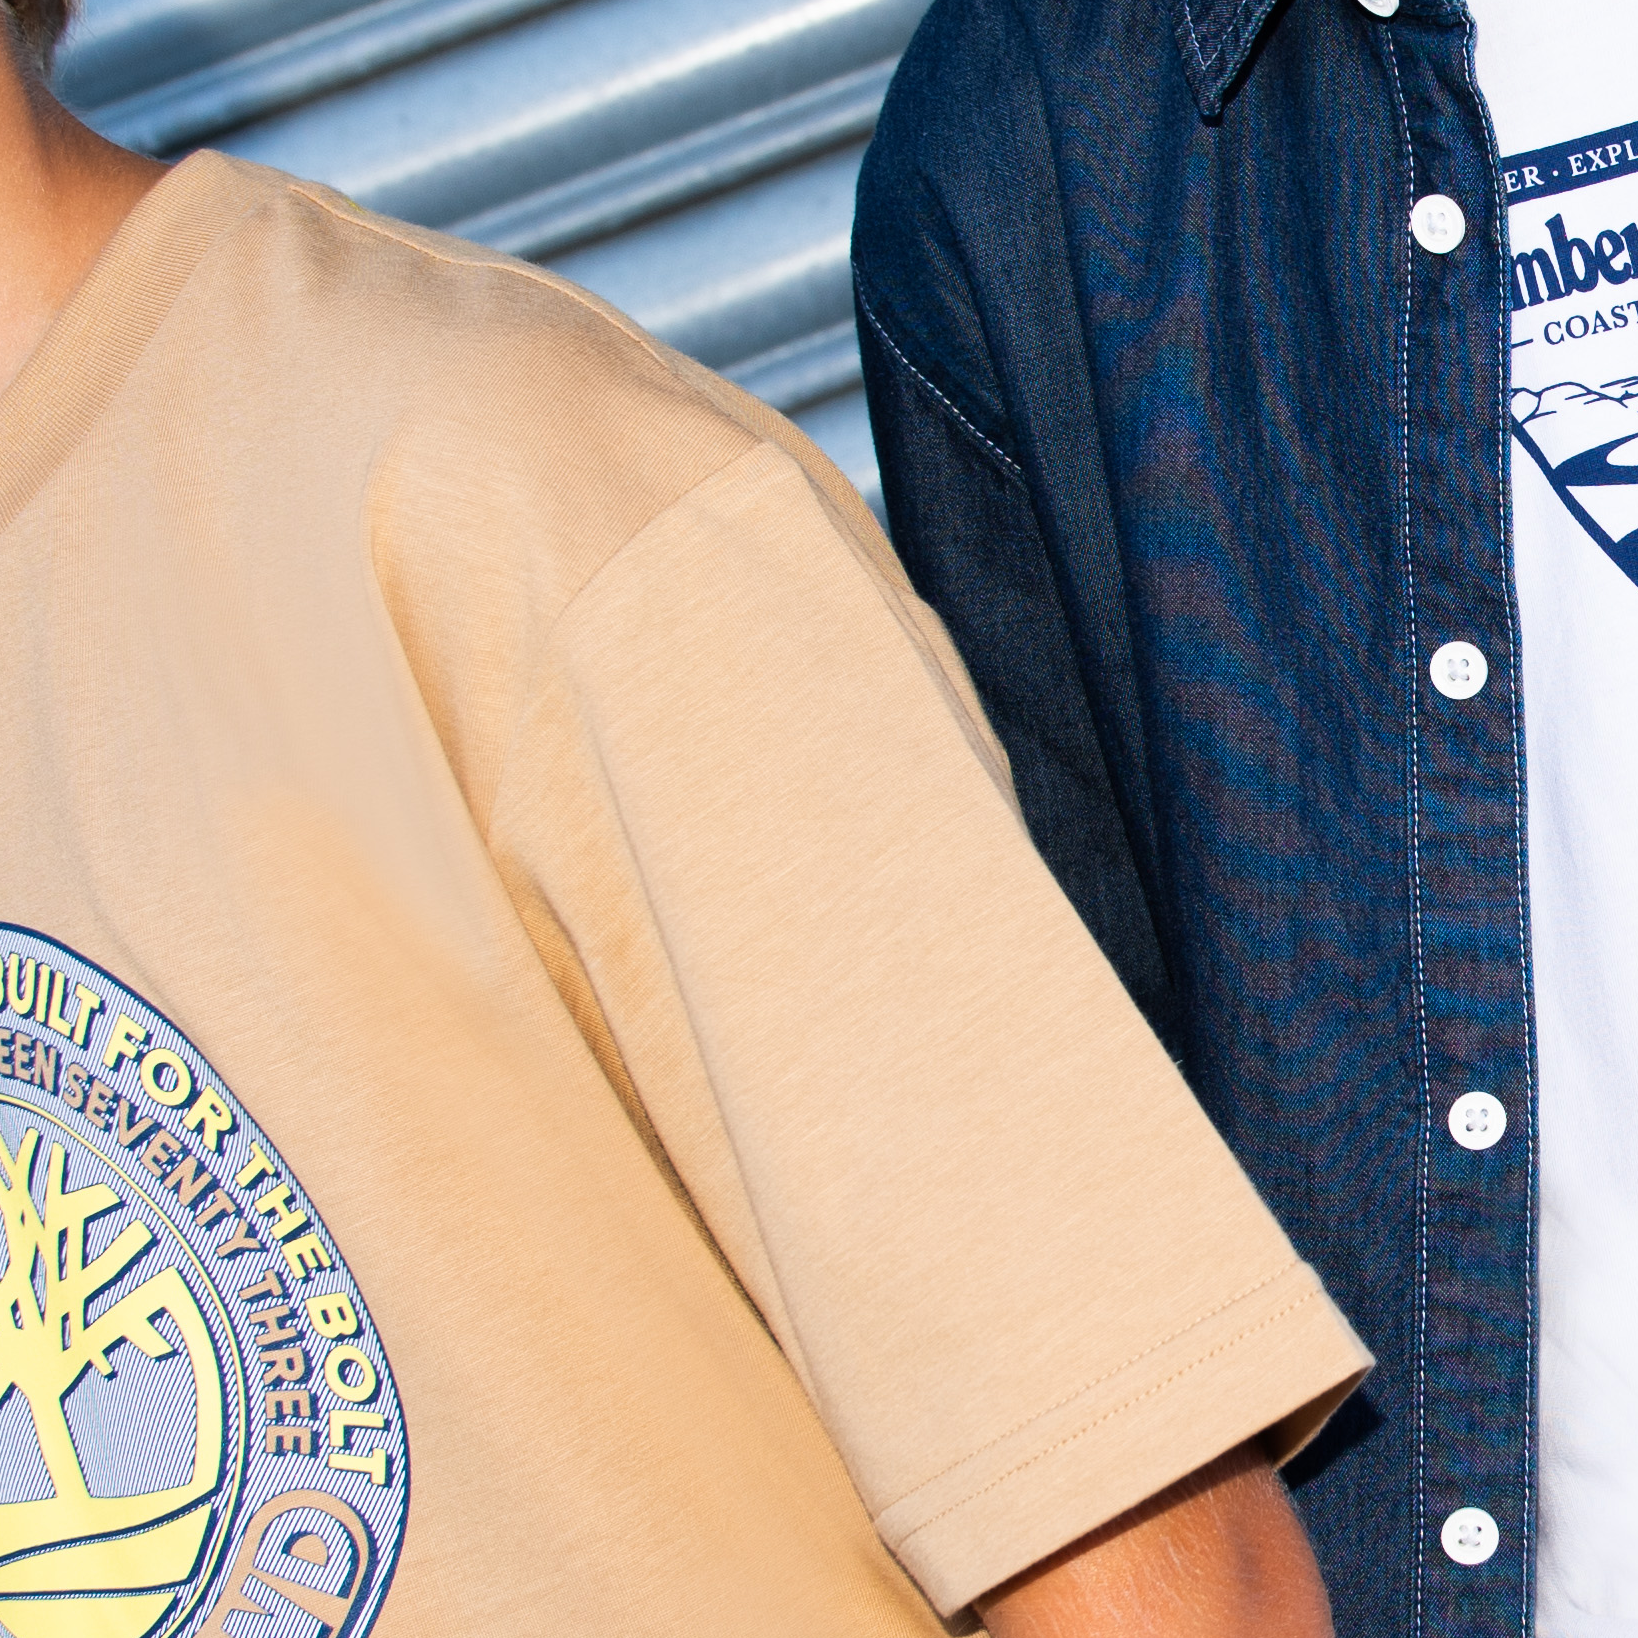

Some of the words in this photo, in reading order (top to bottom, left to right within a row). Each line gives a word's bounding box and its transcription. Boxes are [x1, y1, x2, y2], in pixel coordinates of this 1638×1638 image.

[64, 1062, 262, 1260] SEVENTY
[238, 1271, 314, 1457] THREE
[102, 1013, 236, 1152] FOR
[234, 1141, 334, 1281] THE
[306, 1291, 392, 1486] BOLT
